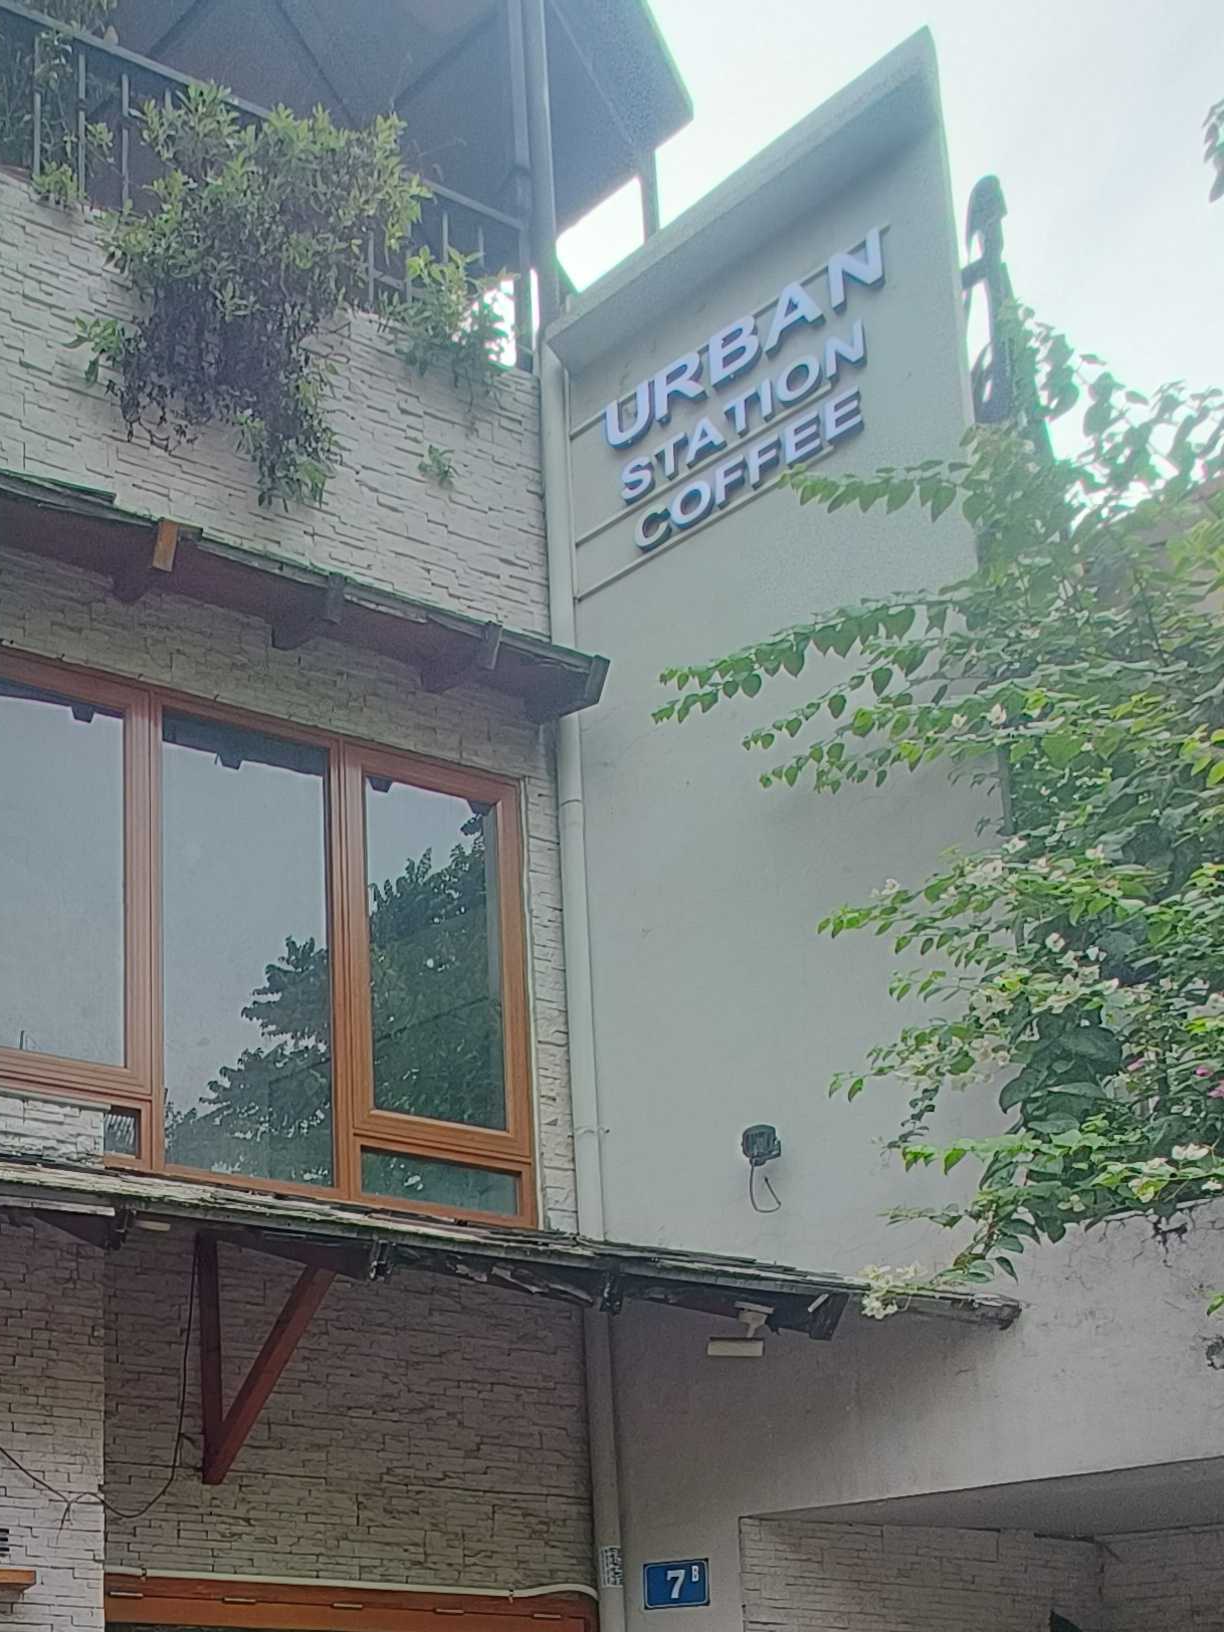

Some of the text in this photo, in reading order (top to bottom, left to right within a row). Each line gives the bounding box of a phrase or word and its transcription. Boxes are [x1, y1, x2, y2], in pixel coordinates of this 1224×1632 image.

[602, 225, 886, 450] URBAN
[621, 319, 866, 504] STATION
[634, 385, 864, 551] COFFEE
